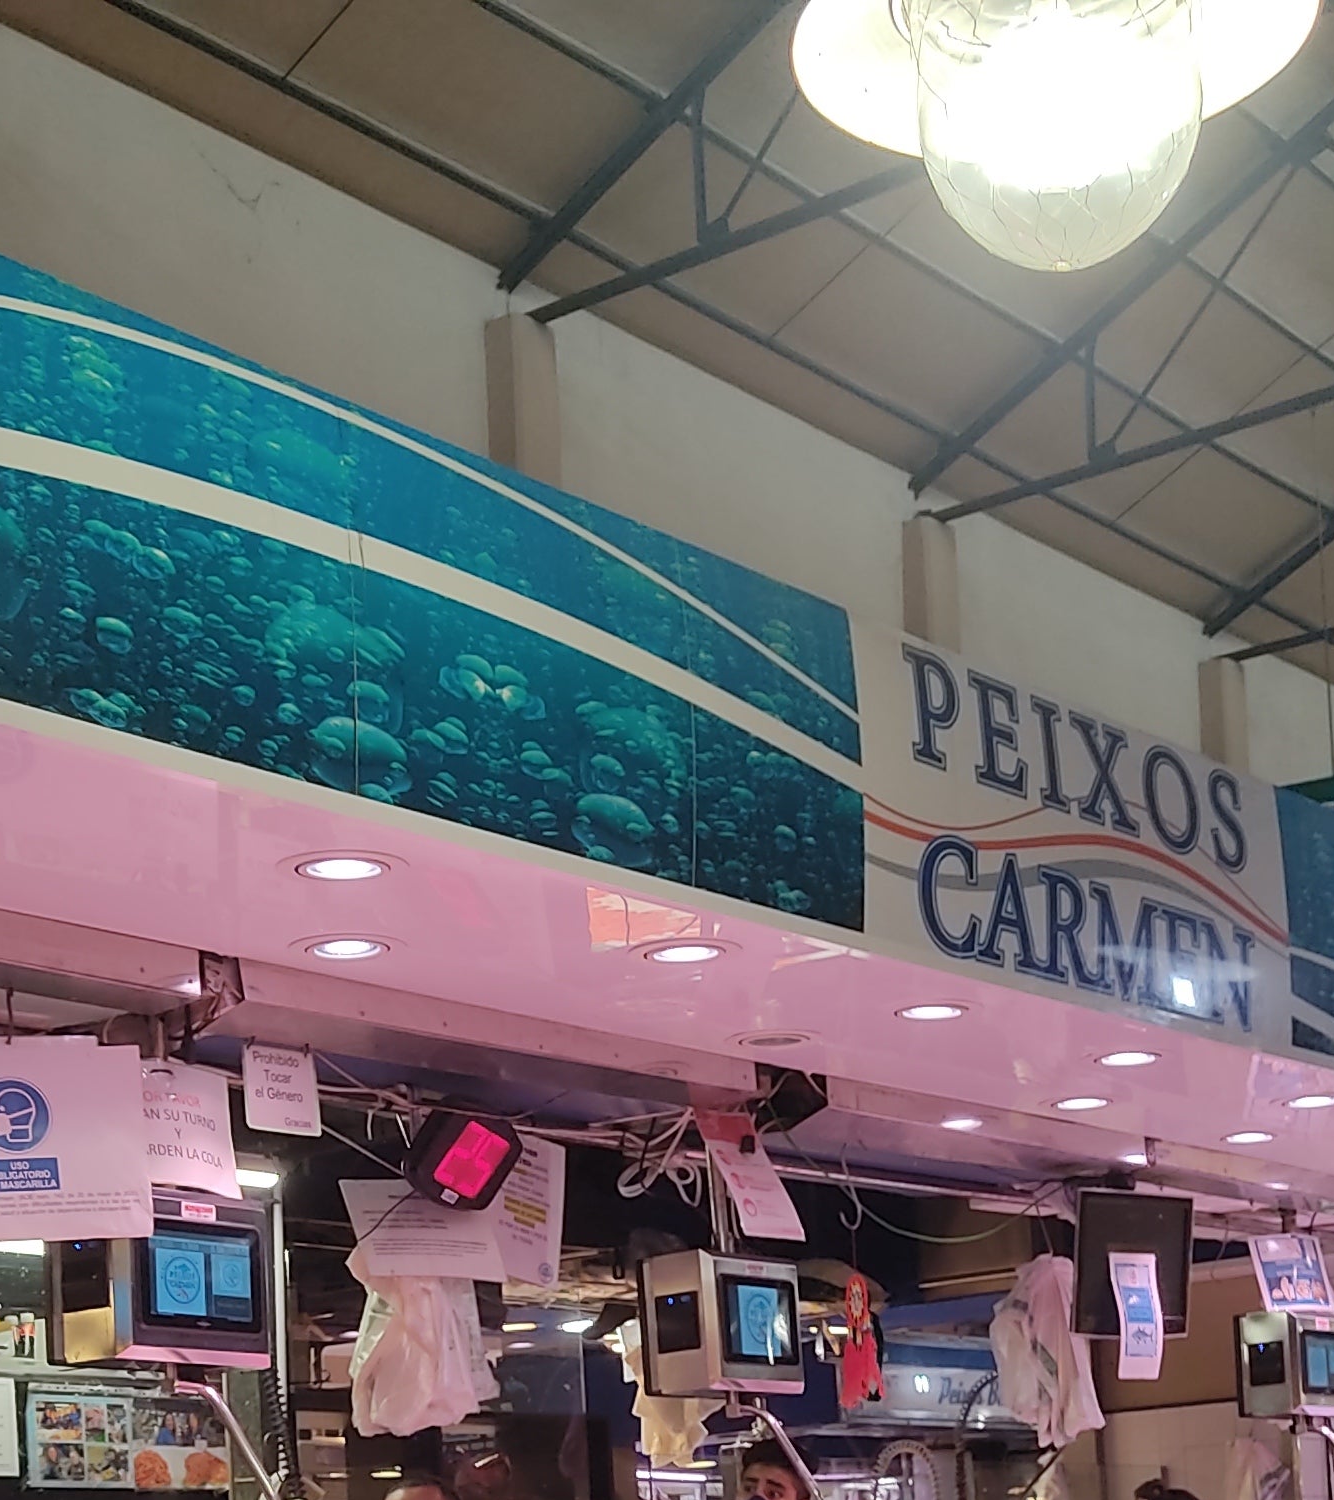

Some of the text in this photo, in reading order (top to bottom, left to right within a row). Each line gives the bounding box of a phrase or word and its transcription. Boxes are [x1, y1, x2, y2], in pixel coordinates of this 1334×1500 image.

[902, 642, 1249, 875] PEIXOS
[917, 835, 1256, 1032] CARMEN
[252, 1050, 300, 1068] Prohibido
[263, 1069, 292, 1084] Tocar
[255, 1087, 304, 1103] el Género
[164, 1108, 180, 1122] SU
[182, 1111, 216, 1132] TURNO
[174, 1127, 182, 1140] Y
[146, 1143, 223, 1169] RDEN LA COLA
[9, 1161, 30, 1171] USO
[0, 1179, 59, 1191] MASCARILLA
